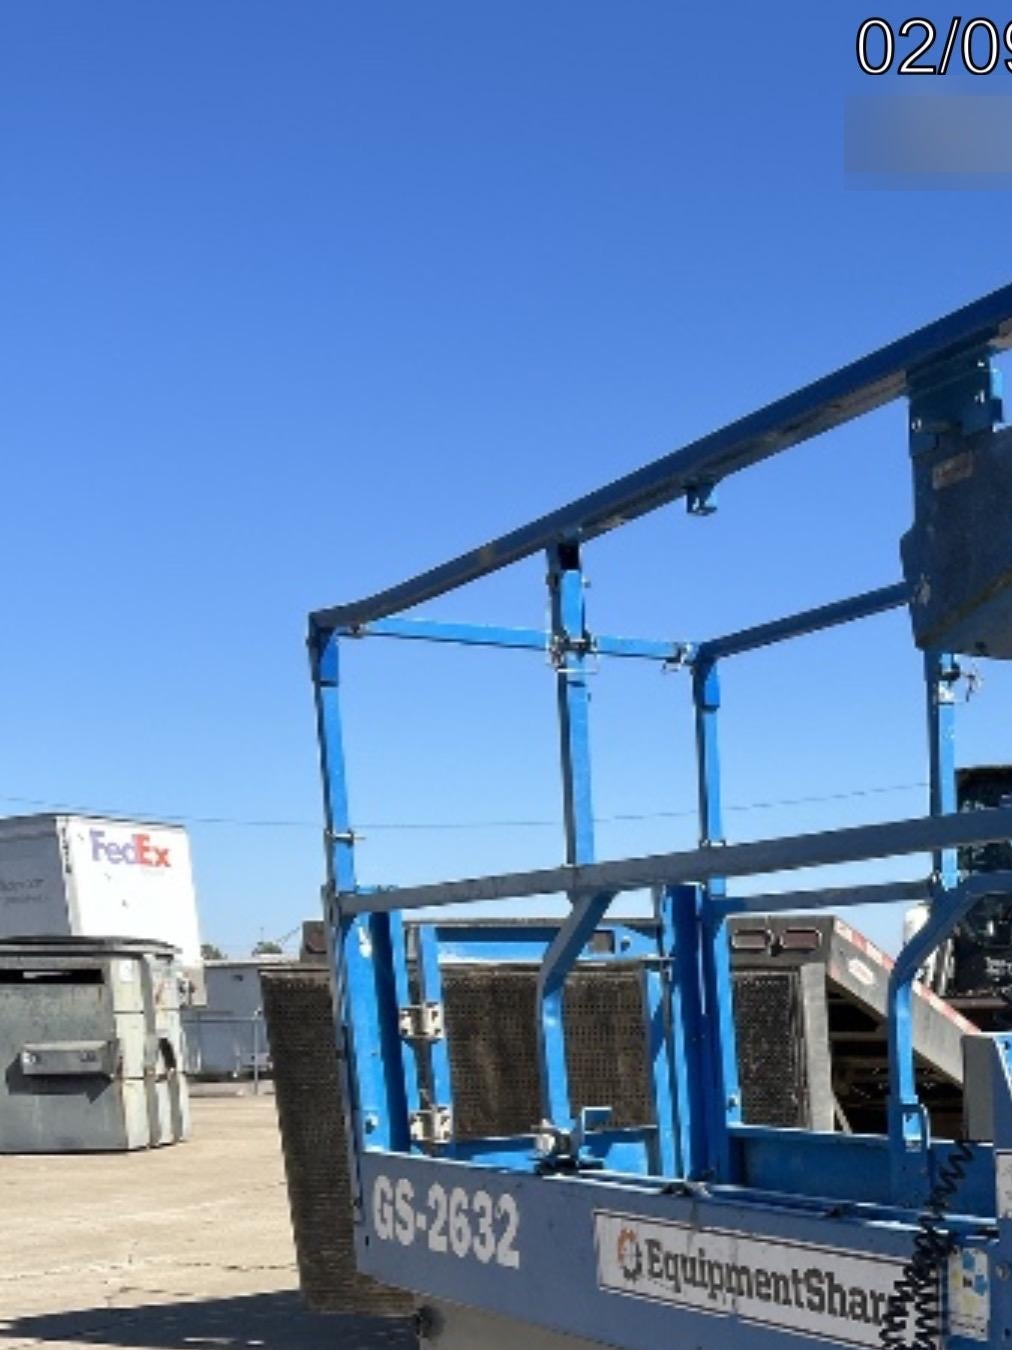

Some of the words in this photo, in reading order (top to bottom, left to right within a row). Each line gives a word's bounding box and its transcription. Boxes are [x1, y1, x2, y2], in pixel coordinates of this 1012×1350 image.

[89, 828, 172, 868] FedEx
[373, 1175, 520, 1269] GS-2632
[645, 1238, 905, 1329] EquipmentShar
